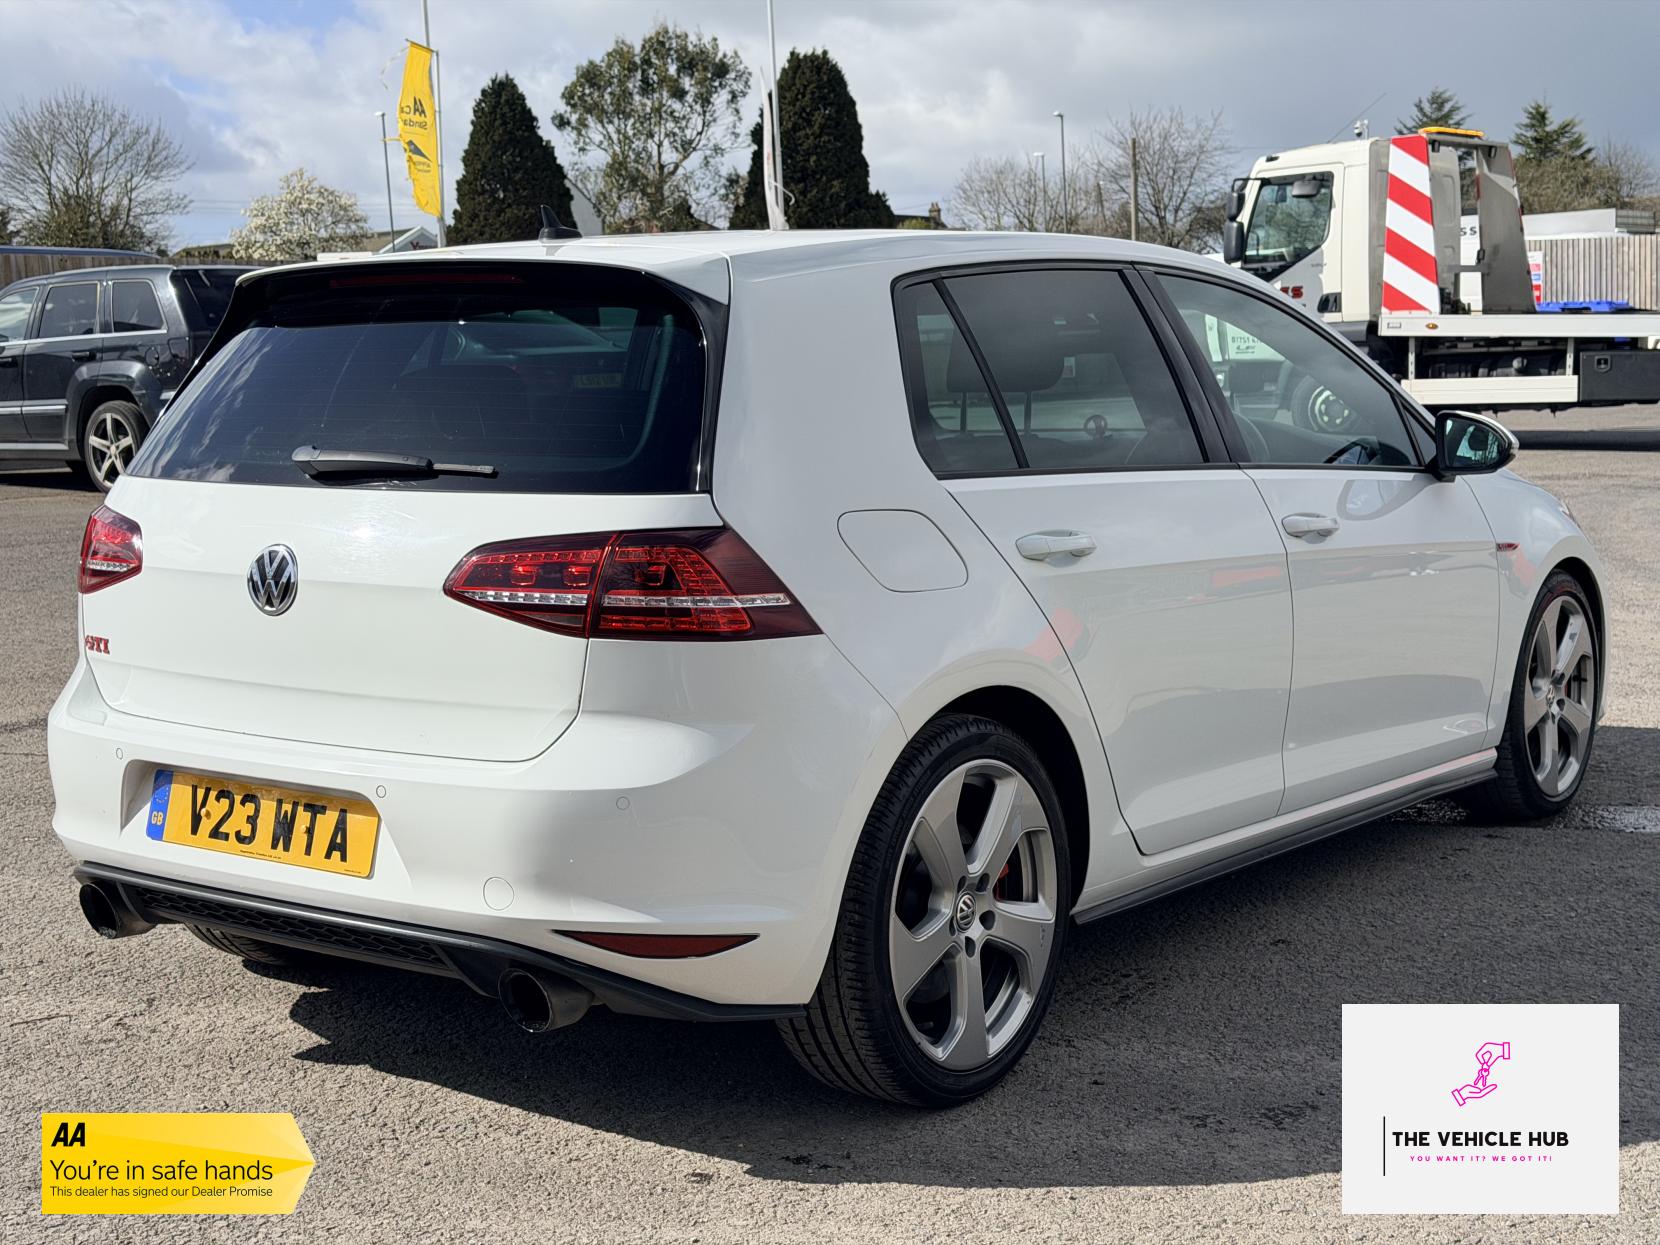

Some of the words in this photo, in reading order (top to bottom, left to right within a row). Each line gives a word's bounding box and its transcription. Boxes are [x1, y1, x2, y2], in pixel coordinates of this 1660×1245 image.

[151, 811, 164, 826] GB
[190, 784, 261, 845] V23
[271, 798, 348, 863] WTA
